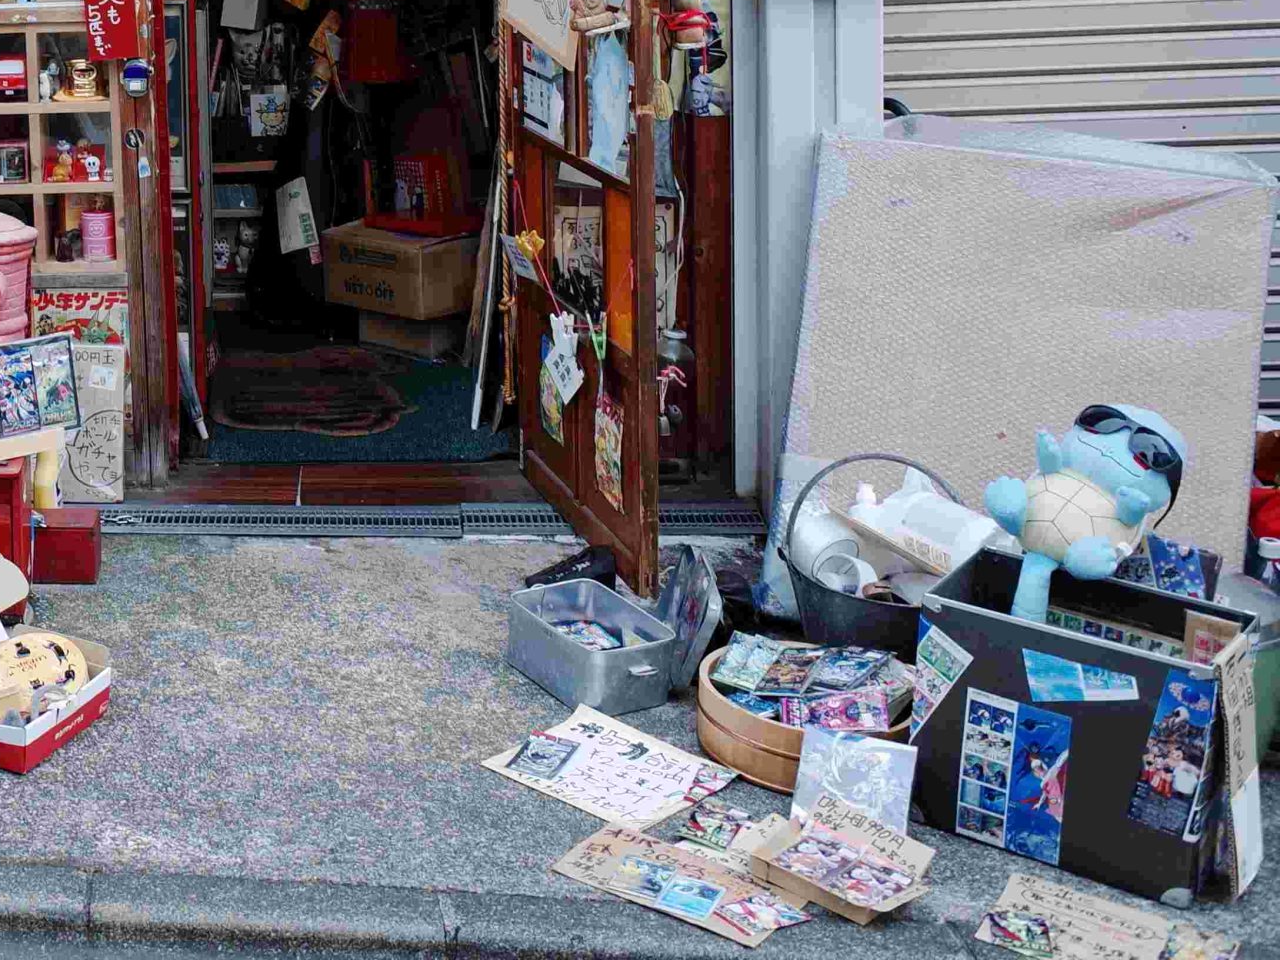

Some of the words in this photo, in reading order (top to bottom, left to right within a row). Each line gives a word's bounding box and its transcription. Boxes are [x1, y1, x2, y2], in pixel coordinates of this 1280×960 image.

[88, 4, 112, 56] 5匹まで
[82, 427, 117, 441] ボール
[77, 442, 116, 463] ガチャ
